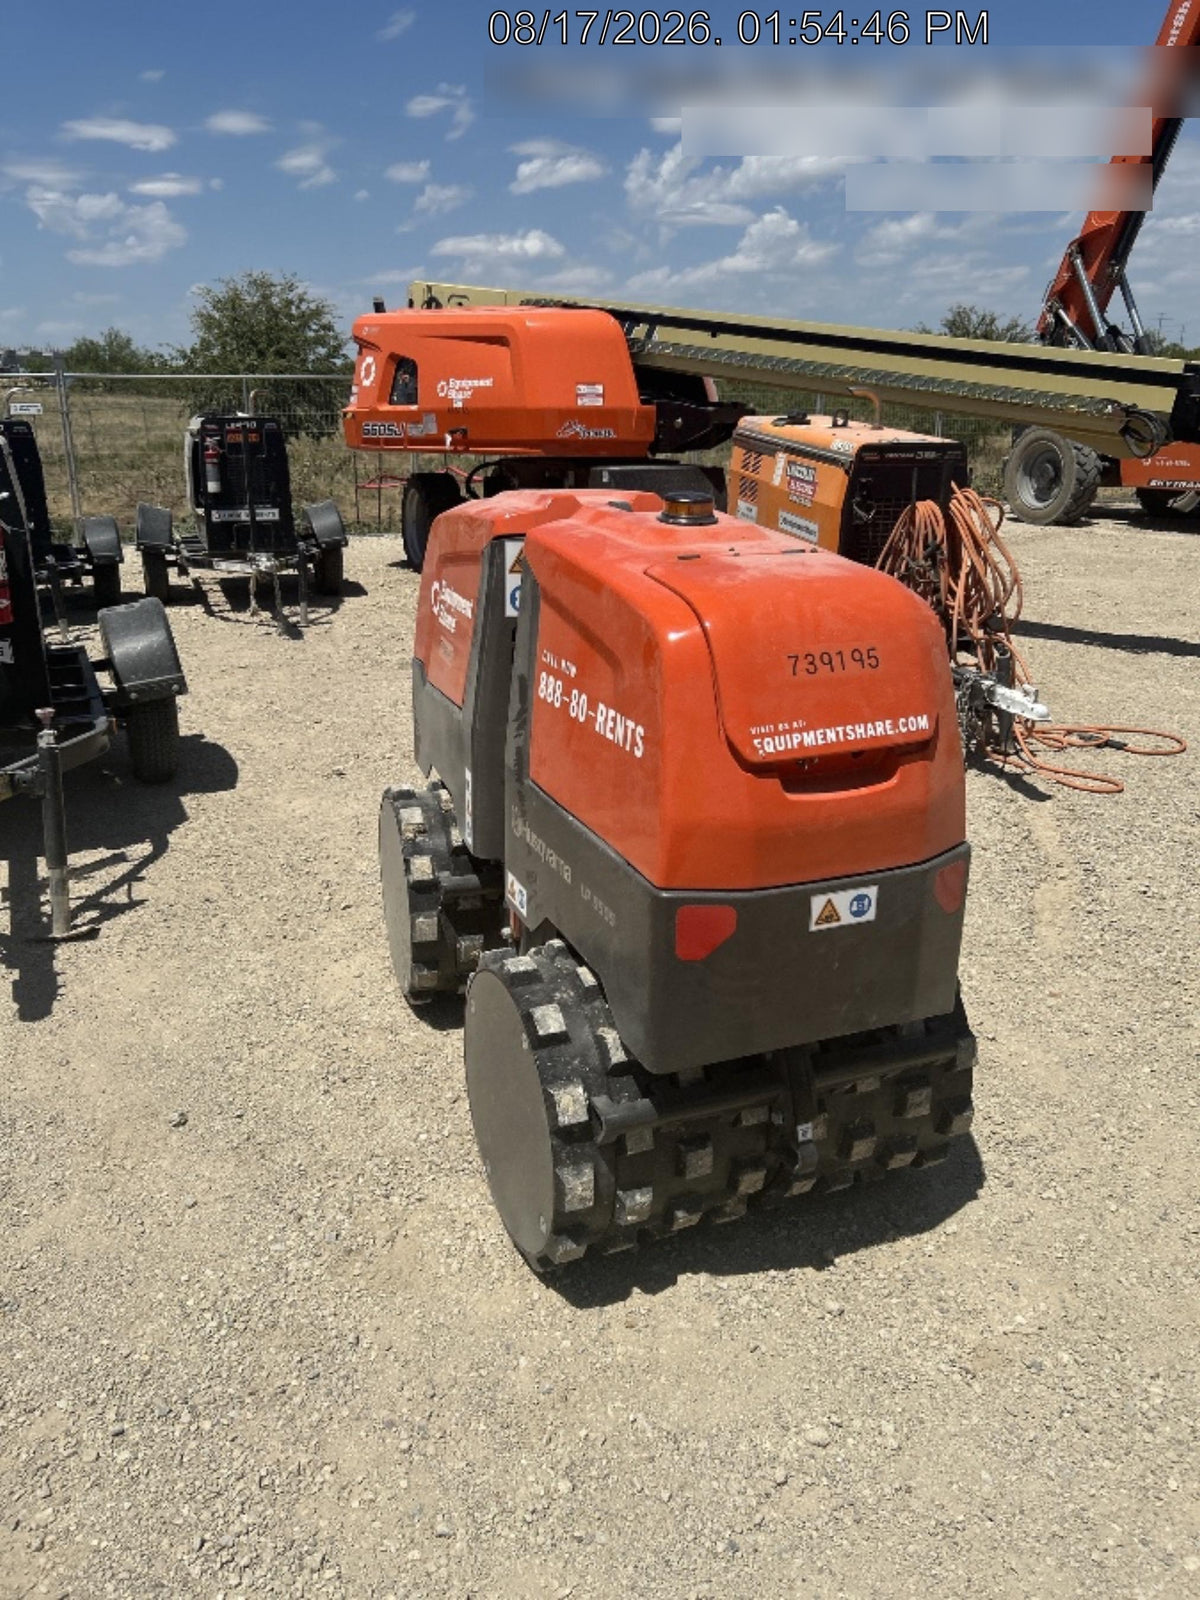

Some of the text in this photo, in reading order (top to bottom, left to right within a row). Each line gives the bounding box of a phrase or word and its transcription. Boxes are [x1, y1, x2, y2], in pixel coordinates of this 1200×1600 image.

[787, 647, 880, 676] 739195
[538, 671, 645, 759] 888-80-RENTS
[749, 723, 775, 735] VISIT
[753, 714, 930, 757] EQUIPMENTSHARE.COM
